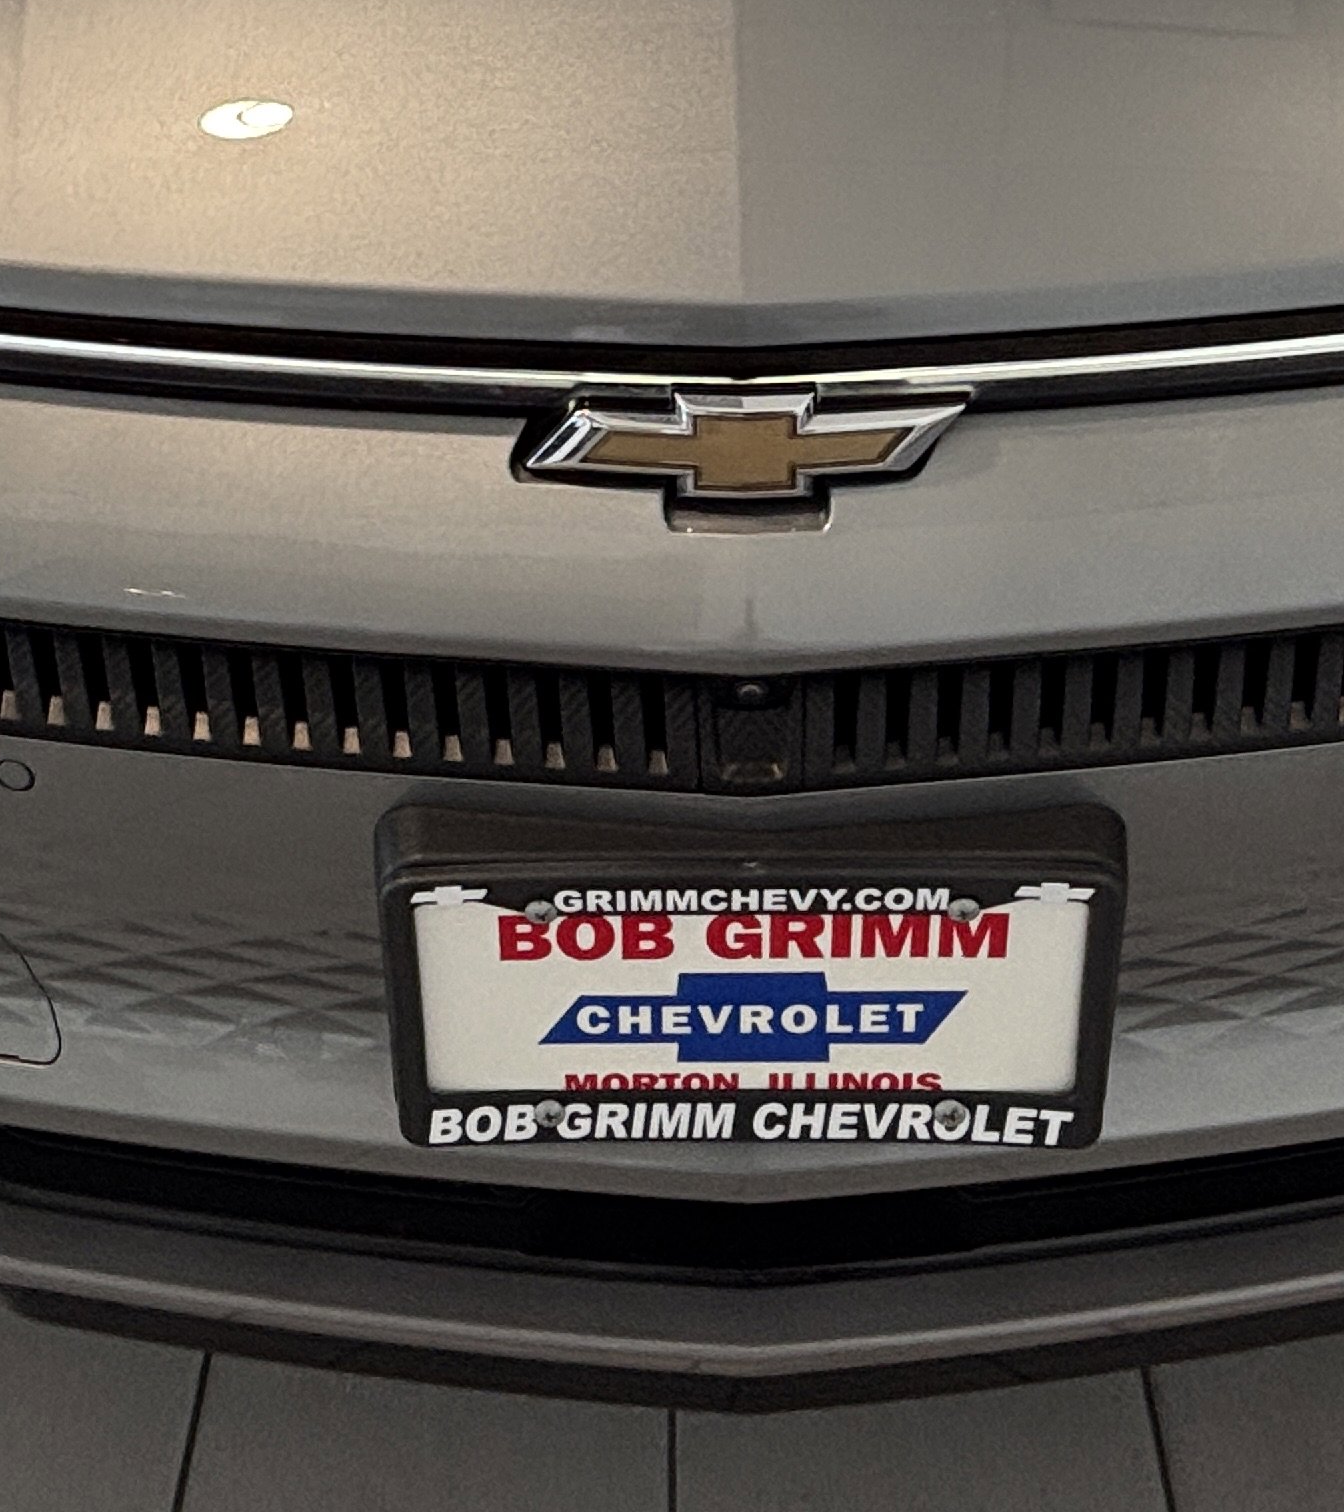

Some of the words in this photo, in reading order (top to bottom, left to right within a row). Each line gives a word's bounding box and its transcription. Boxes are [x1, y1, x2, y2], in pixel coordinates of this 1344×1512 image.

[554, 888, 950, 913] GRIMMCHEVY.COM
[498, 913, 675, 961] BOB
[705, 913, 1010, 959] GRIMM
[576, 1004, 924, 1034] CHEVROLET
[564, 1072, 739, 1092] MORTON
[429, 1105, 538, 1144] BOB
[557, 1102, 736, 1139] GRIMM
[753, 1102, 1074, 1146] CHEVROLET
